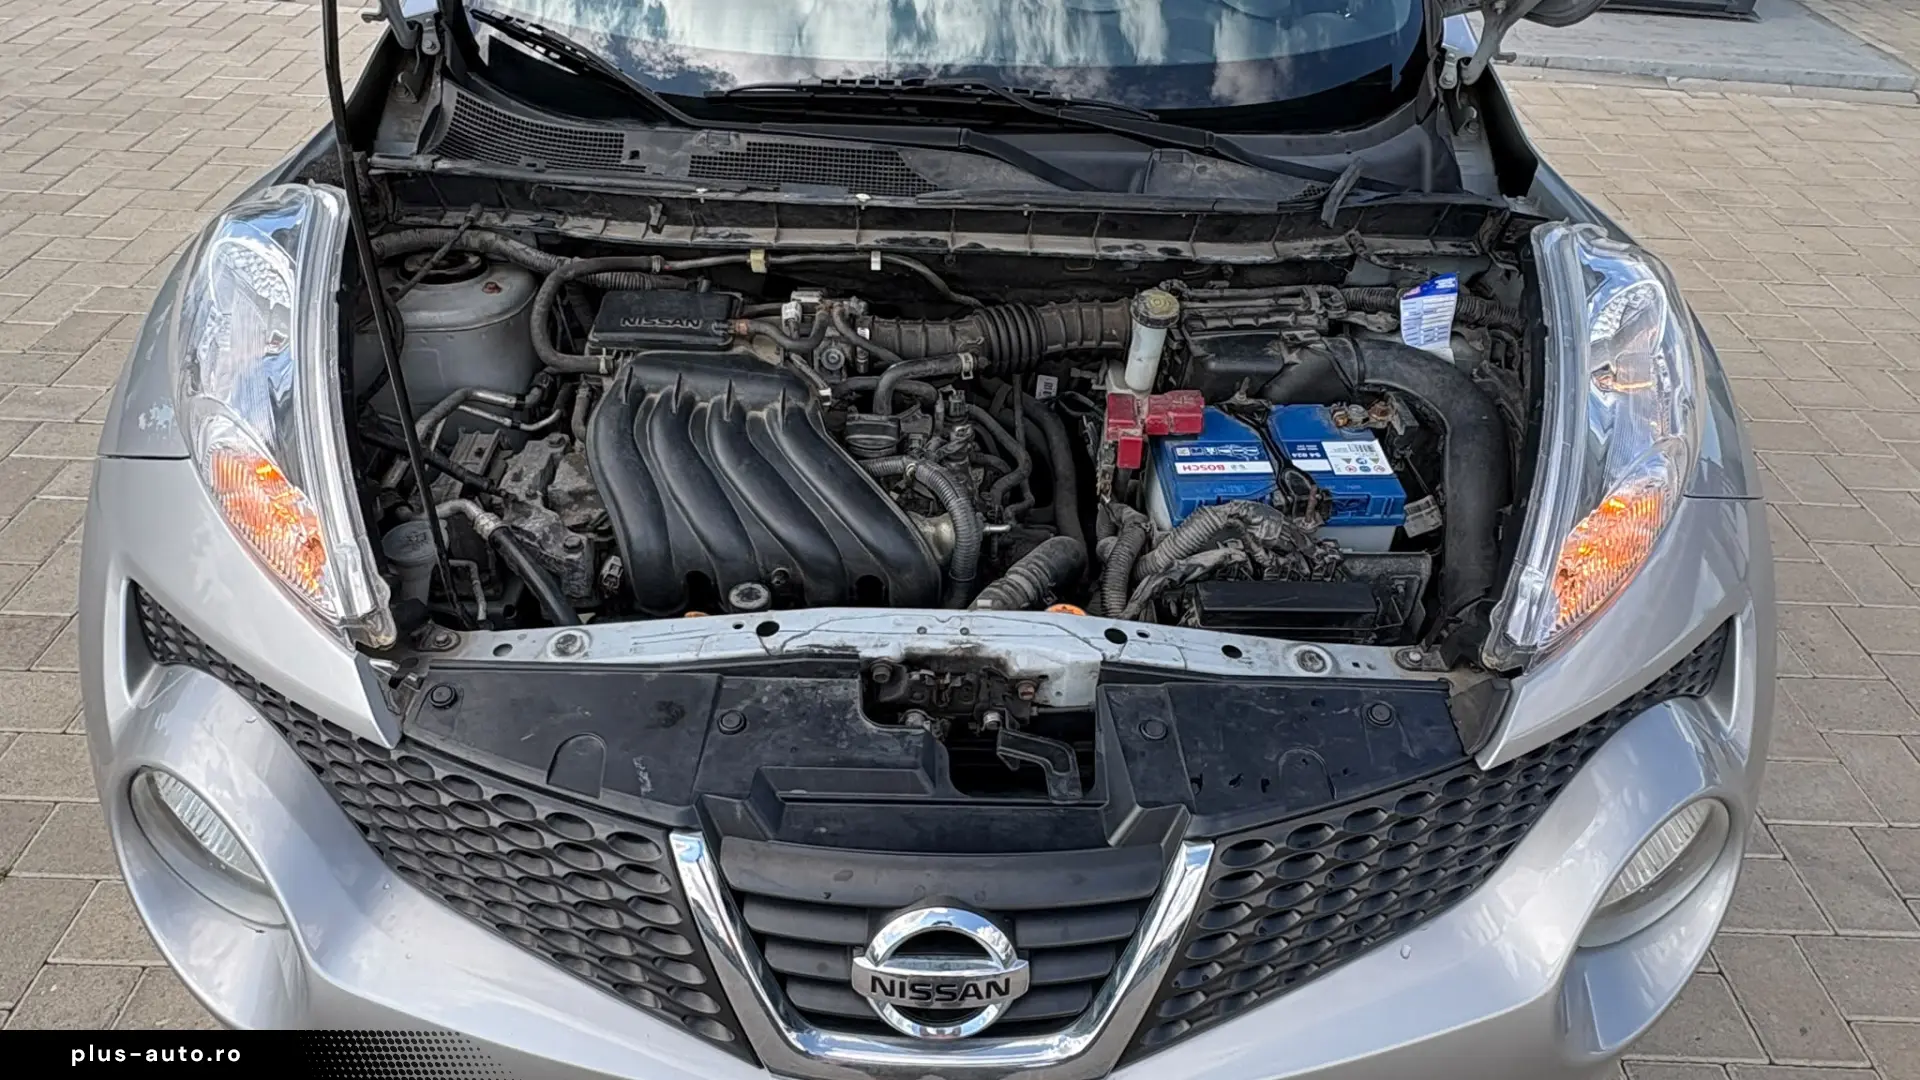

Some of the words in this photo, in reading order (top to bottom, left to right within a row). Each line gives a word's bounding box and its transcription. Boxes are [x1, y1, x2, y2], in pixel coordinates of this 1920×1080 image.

[620, 316, 702, 329] NISSAN
[1182, 464, 1226, 472] BOSCH
[870, 975, 1011, 1002] NISSAN
